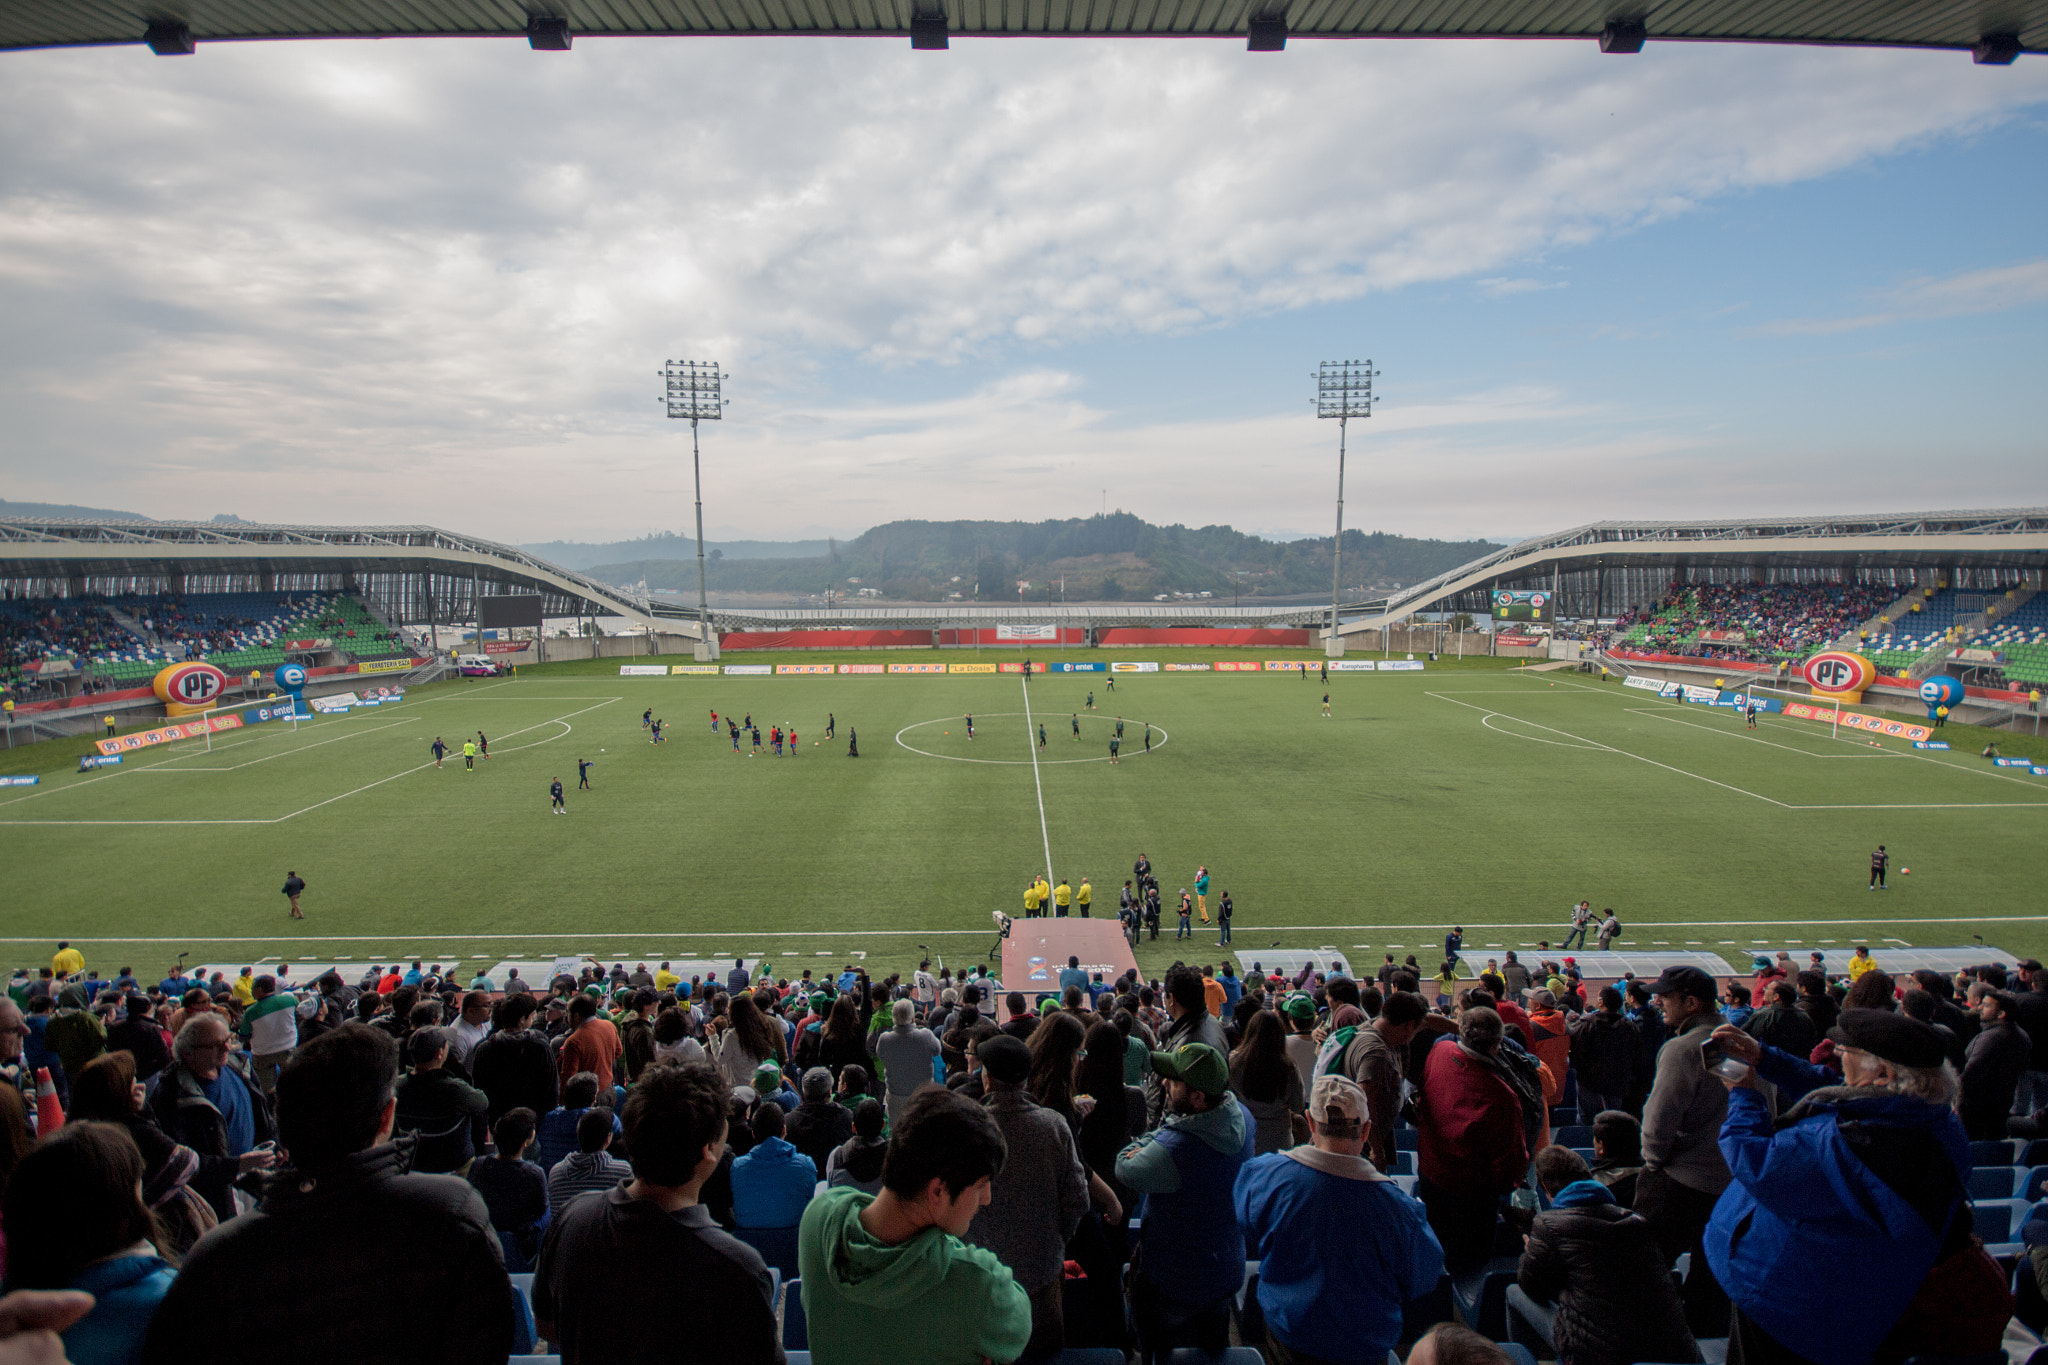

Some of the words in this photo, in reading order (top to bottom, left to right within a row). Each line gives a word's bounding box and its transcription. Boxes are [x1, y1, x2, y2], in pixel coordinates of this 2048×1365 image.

[1626, 677, 1642, 685] SANTO
[1817, 661, 1848, 685] PF
[184, 673, 214, 697] PF
[273, 704, 294, 715] entel
[1869, 720, 1880, 729] PF
[1890, 724, 1901, 733] PF
[1911, 728, 1922, 737] PF
[105, 742, 116, 750] PF
[126, 737, 138, 746] PF
[147, 733, 158, 741] PF
[919, 978, 926, 989] 8
